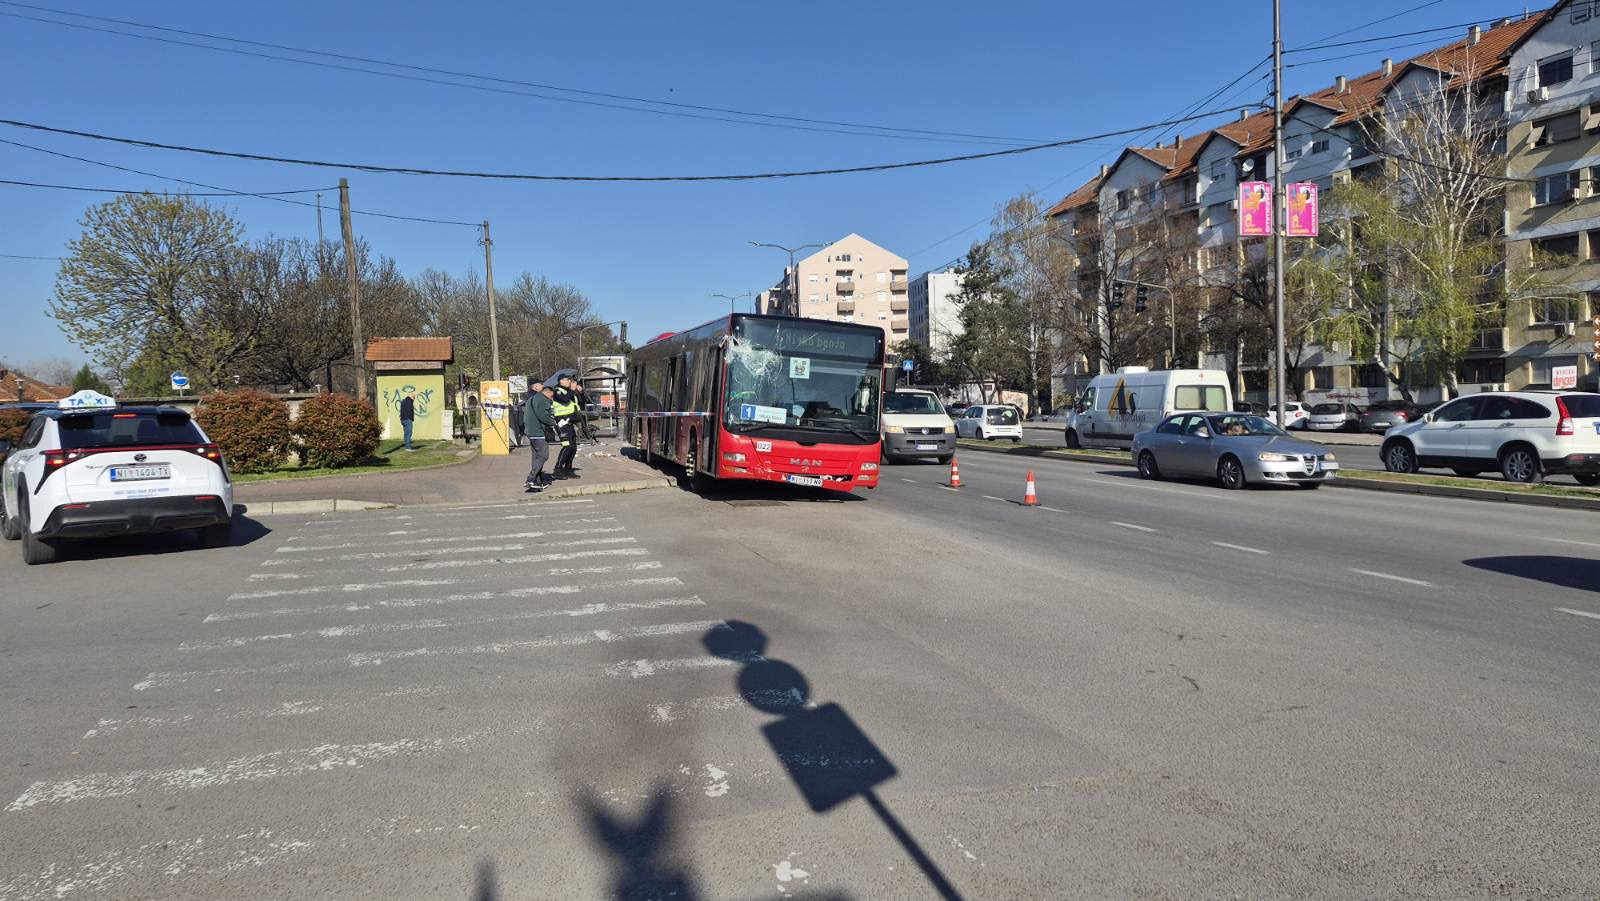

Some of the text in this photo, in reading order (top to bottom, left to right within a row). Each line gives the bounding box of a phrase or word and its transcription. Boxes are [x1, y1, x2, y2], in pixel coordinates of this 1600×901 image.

[68, 397, 108, 406] TAXI
[746, 407, 751, 418] 1
[757, 442, 771, 451] 022
[790, 457, 822, 466] MAN
